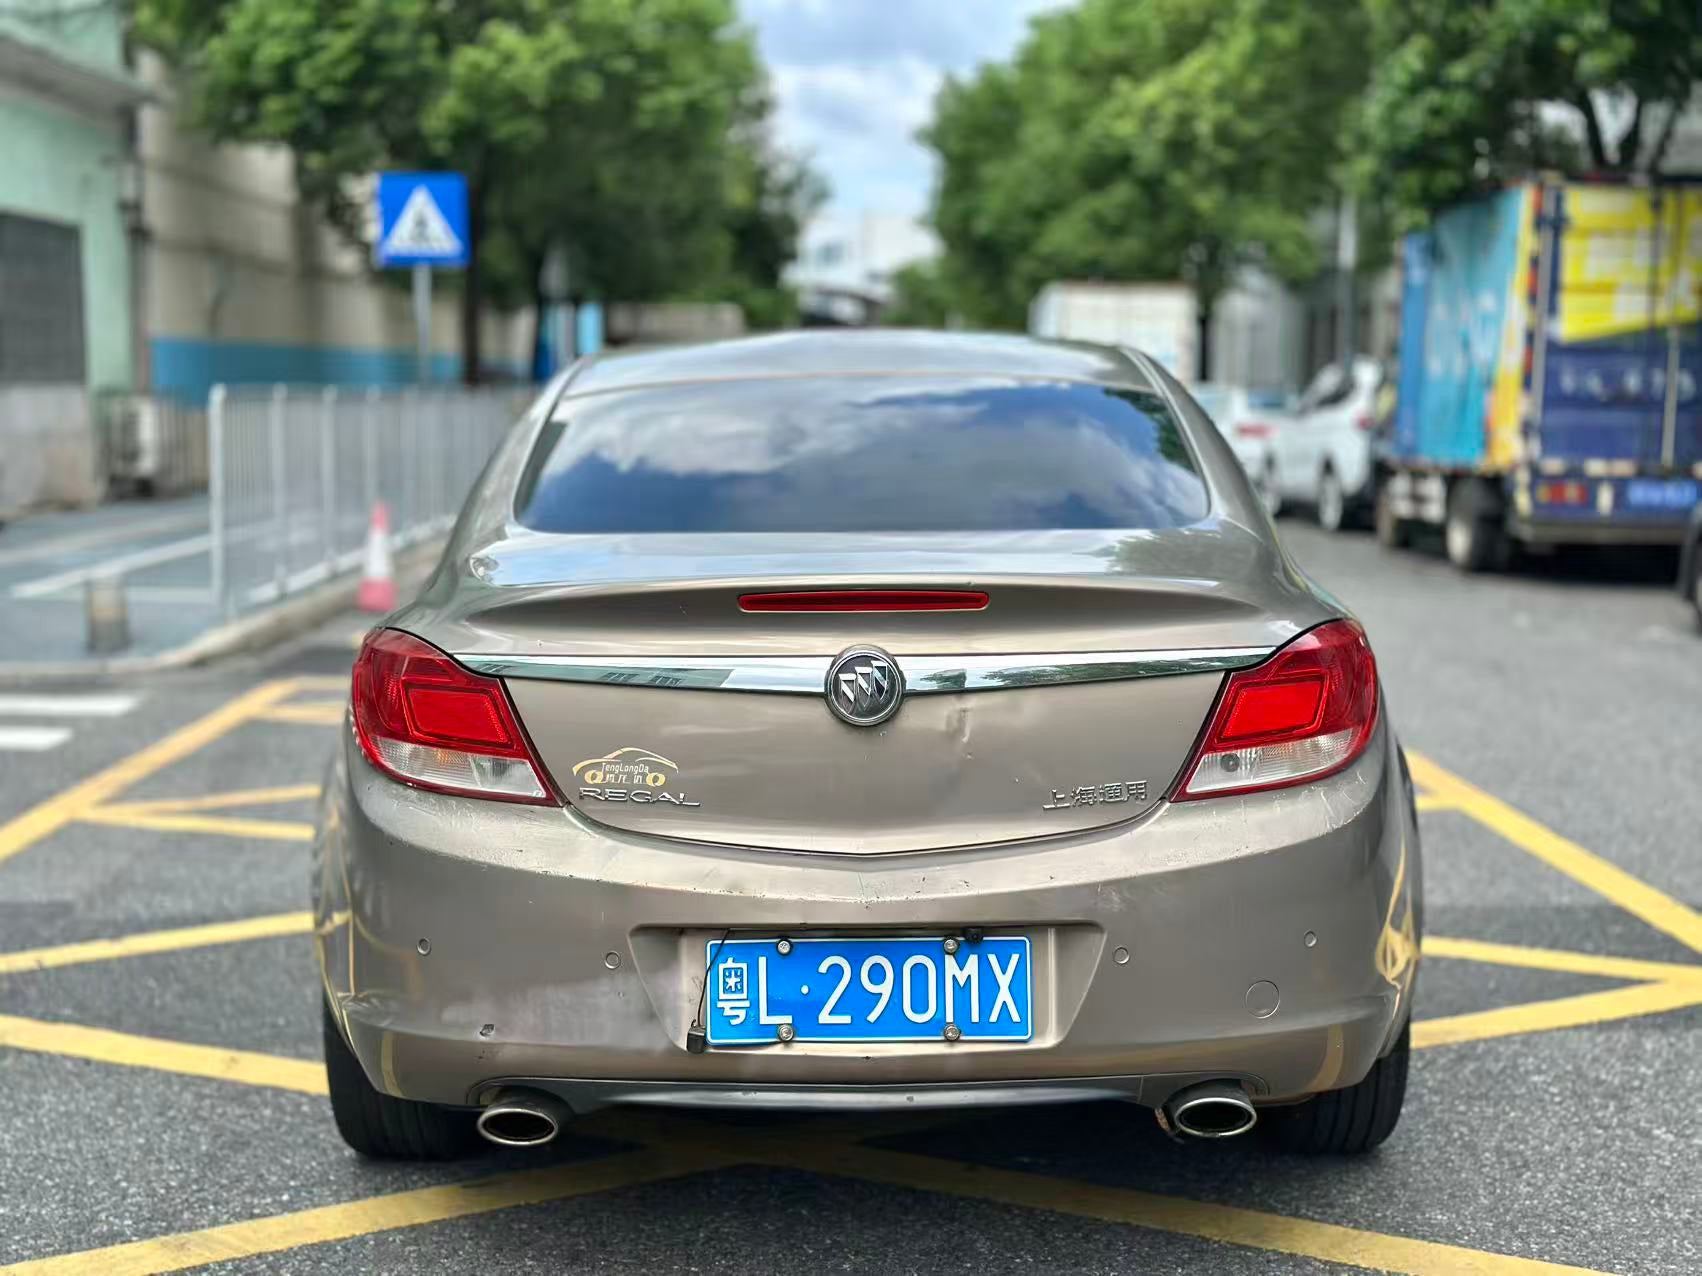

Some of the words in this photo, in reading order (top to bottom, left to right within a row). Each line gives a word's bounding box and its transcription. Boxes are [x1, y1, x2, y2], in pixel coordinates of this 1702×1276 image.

[579, 787, 701, 806] REGAL
[1043, 780, 1147, 809] 上海通用
